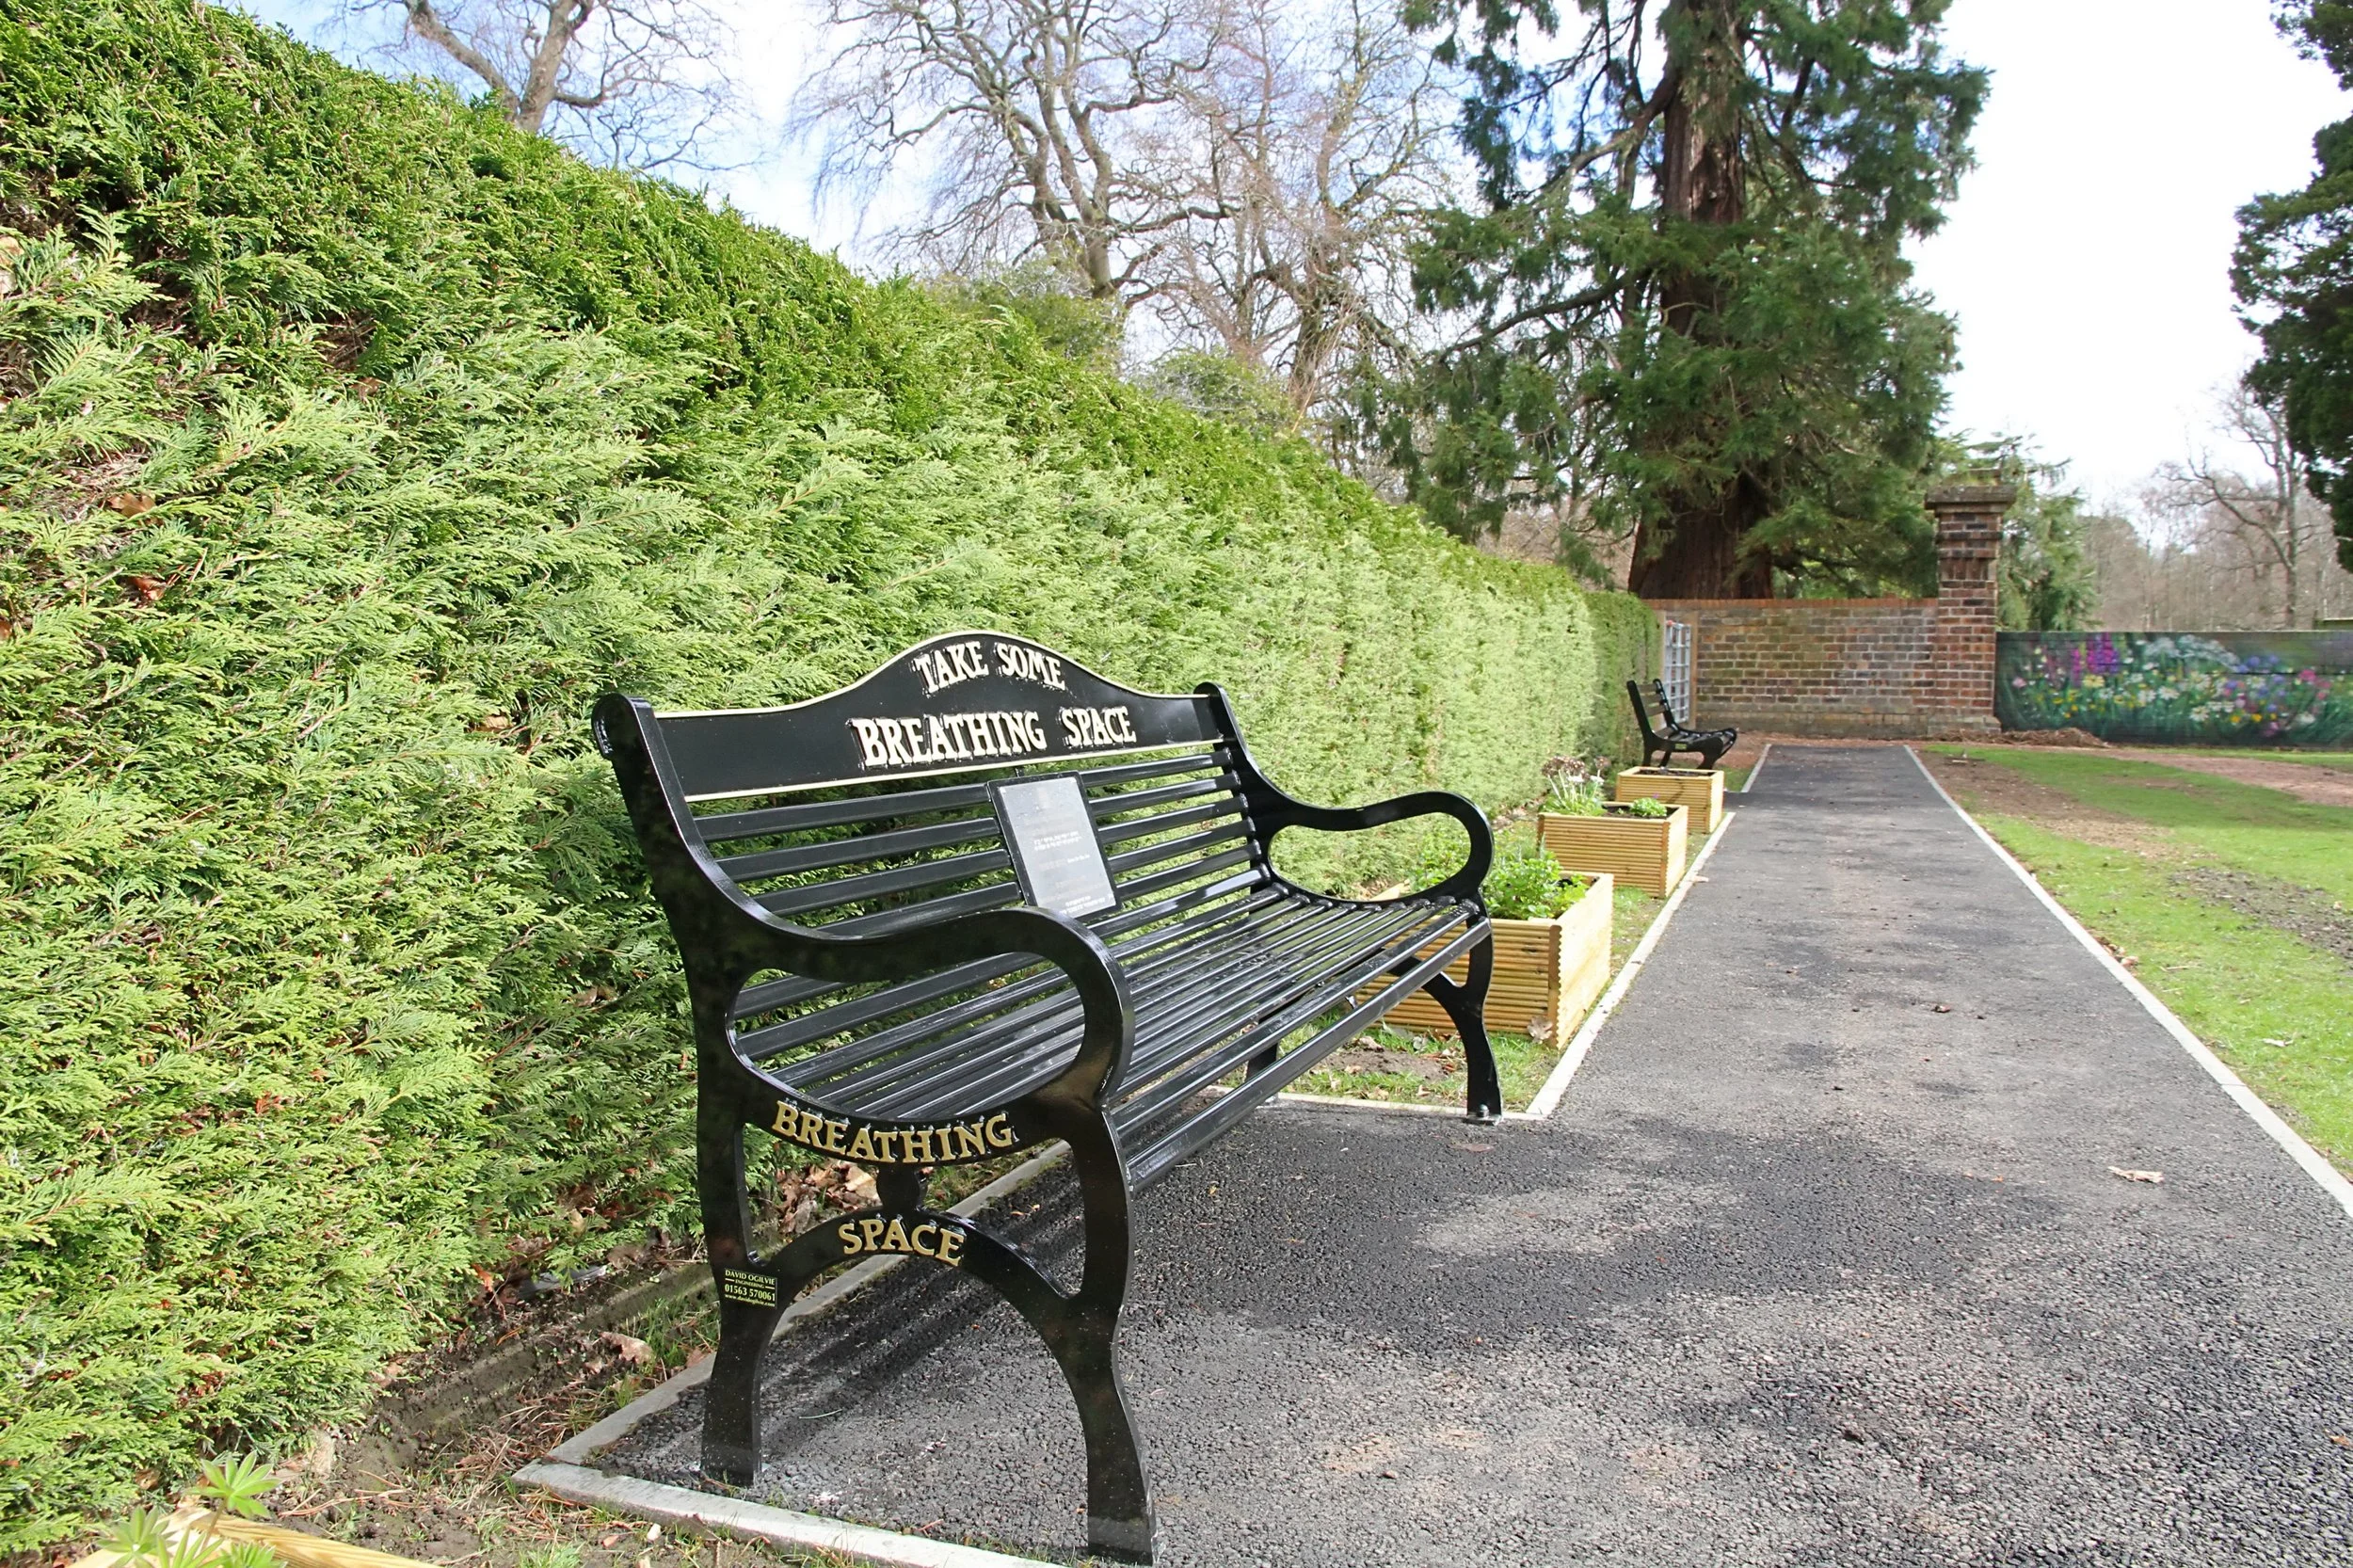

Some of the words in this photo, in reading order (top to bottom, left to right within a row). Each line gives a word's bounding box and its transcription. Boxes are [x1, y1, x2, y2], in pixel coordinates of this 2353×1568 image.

[913, 641, 988, 694] TAKE
[995, 642, 1065, 689] SOME
[851, 711, 1047, 768] BREATHING
[1061, 707, 1136, 747] SPACE
[773, 1099, 1013, 1163] BREATHING
[839, 1219, 965, 1267] SPACE
[725, 1270, 746, 1279] DAVID
[748, 1274, 775, 1285] OGILVIE
[725, 1284, 747, 1295] 01563
[749, 1288, 775, 1301] 570061
